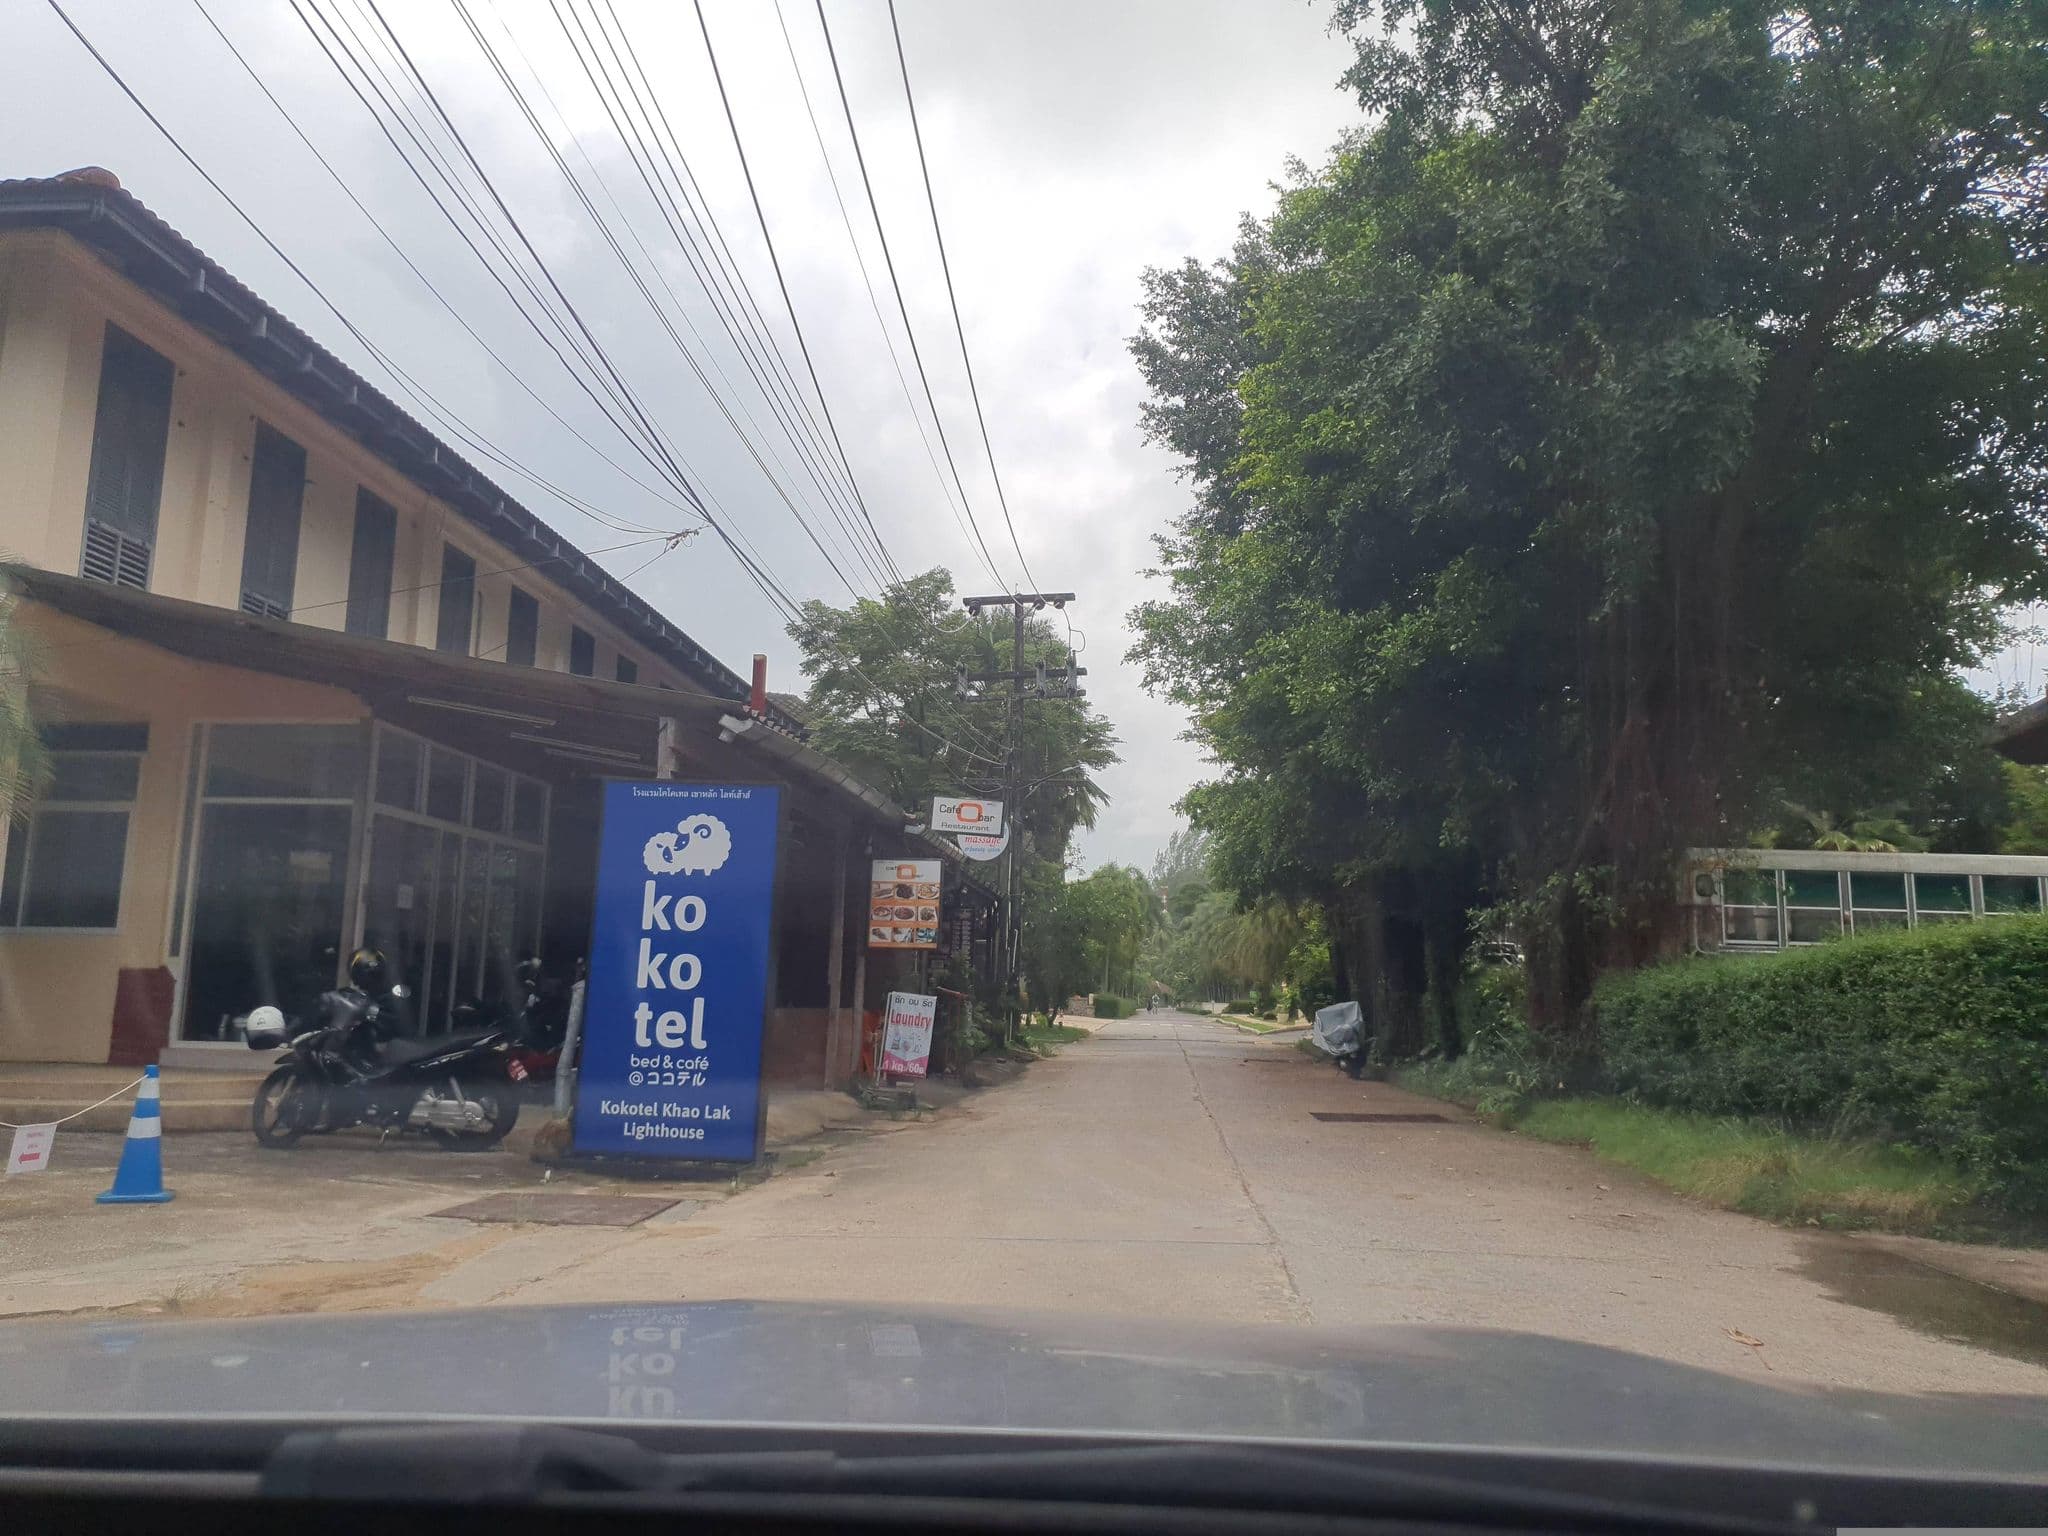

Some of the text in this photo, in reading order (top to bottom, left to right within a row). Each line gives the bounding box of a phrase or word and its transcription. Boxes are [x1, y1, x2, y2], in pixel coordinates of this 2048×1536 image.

[941, 821, 989, 832] Restaurant
[642, 880, 707, 932] ko
[636, 937, 702, 990] ko
[634, 997, 707, 1050] tel
[890, 1009, 932, 1032] Laundry
[630, 1054, 709, 1070] bed & café
[647, 1071, 706, 1086] ココテル
[600, 1100, 731, 1120] Kokotel Khao Lak
[623, 1121, 705, 1140] Lighthouse
